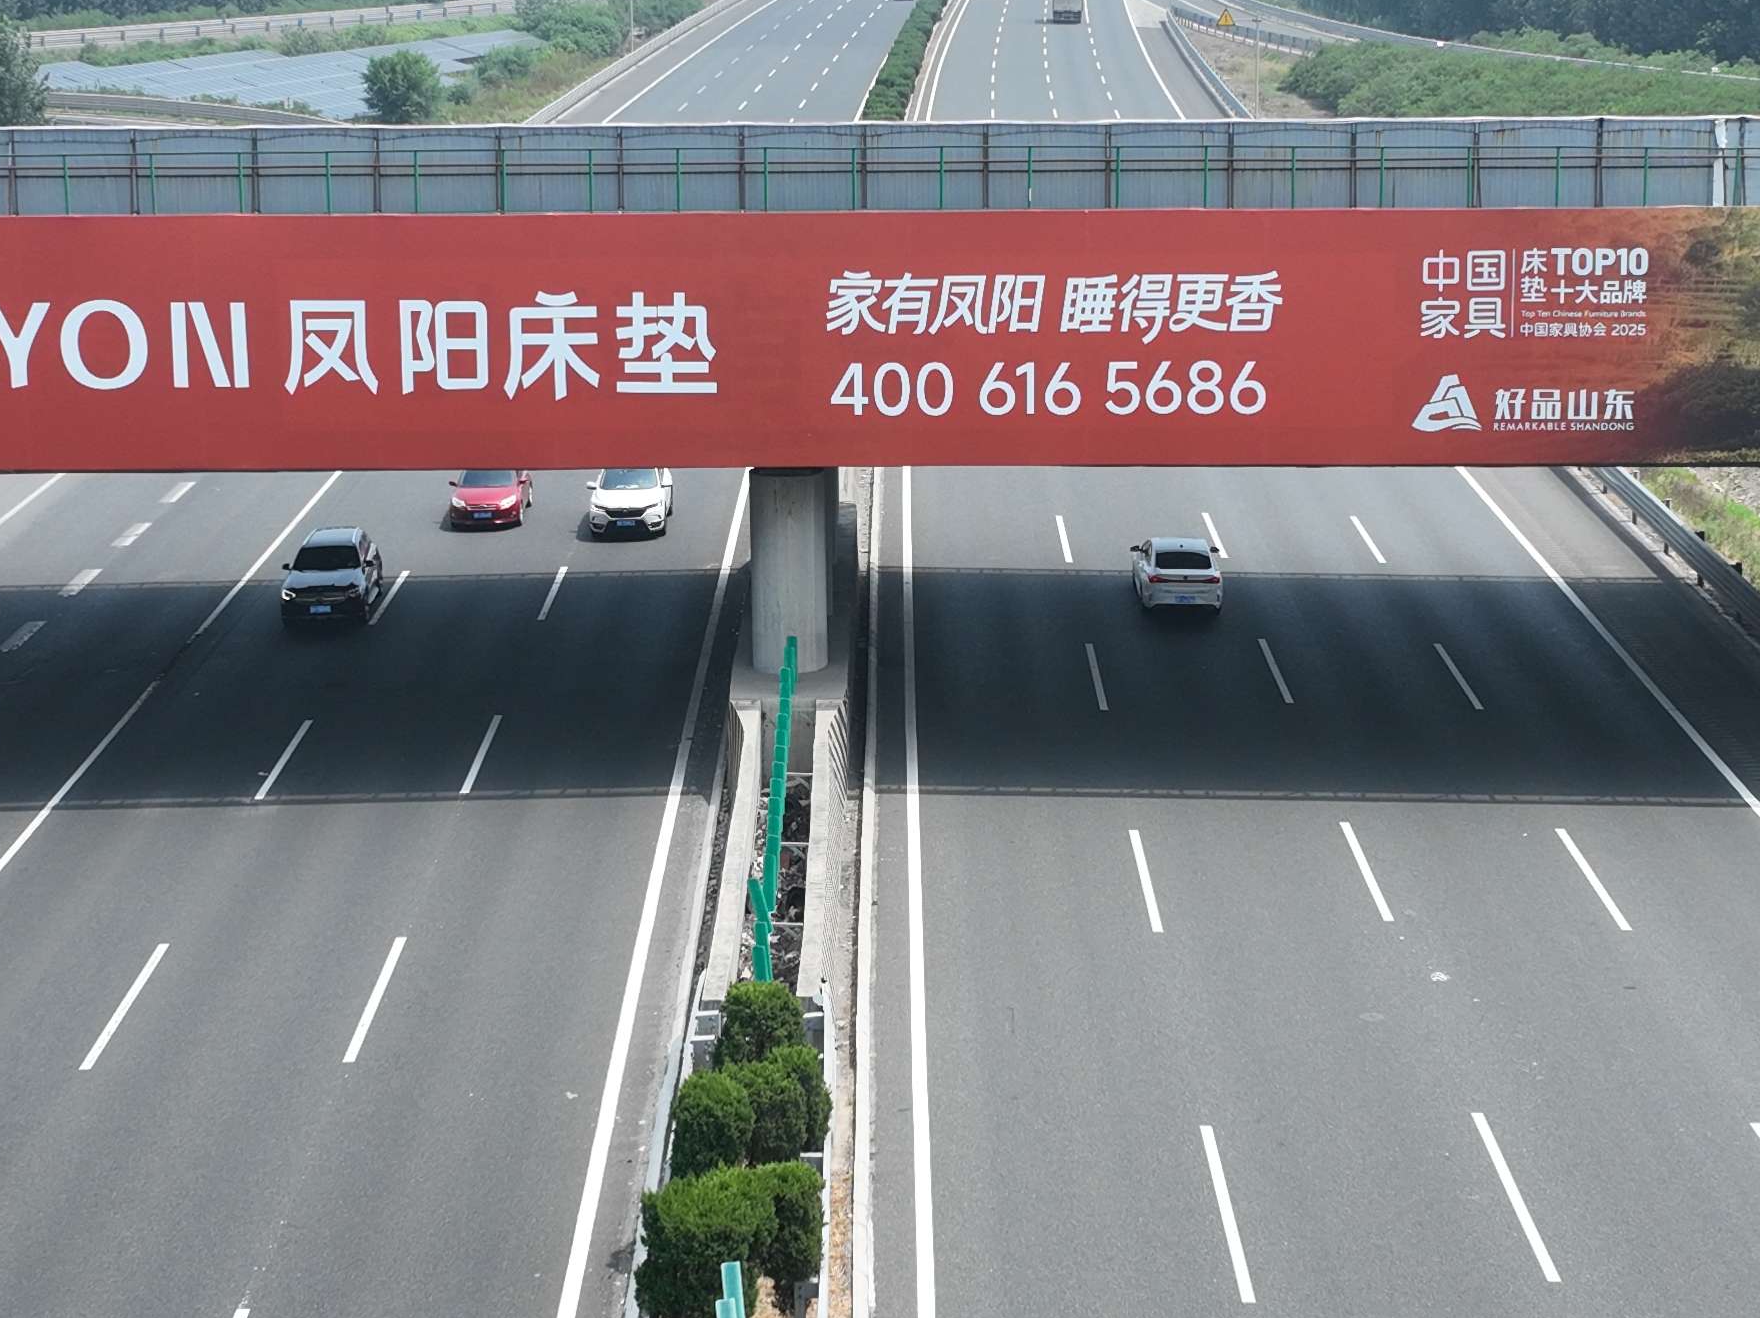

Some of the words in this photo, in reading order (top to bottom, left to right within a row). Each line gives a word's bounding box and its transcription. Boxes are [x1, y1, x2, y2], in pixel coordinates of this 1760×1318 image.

[1423, 250, 1505, 291] 中国
[826, 271, 1045, 334] 家有凤阳
[1060, 271, 1282, 344] 睡得更香
[1421, 297, 1505, 338] 家具
[1521, 310, 1535, 318] Top
[285, 291, 717, 400] 凤阳床垫
[1521, 322, 1606, 337] 中国家具协会
[1611, 324, 1646, 335] 2025
[831, 362, 953, 416] 400
[980, 362, 1081, 415] 616
[1105, 361, 1266, 415] 5686
[1495, 389, 1634, 419] 好品山东
[1494, 422, 1566, 430] REMARKABLE
[1571, 422, 1634, 430] SHANDONG
